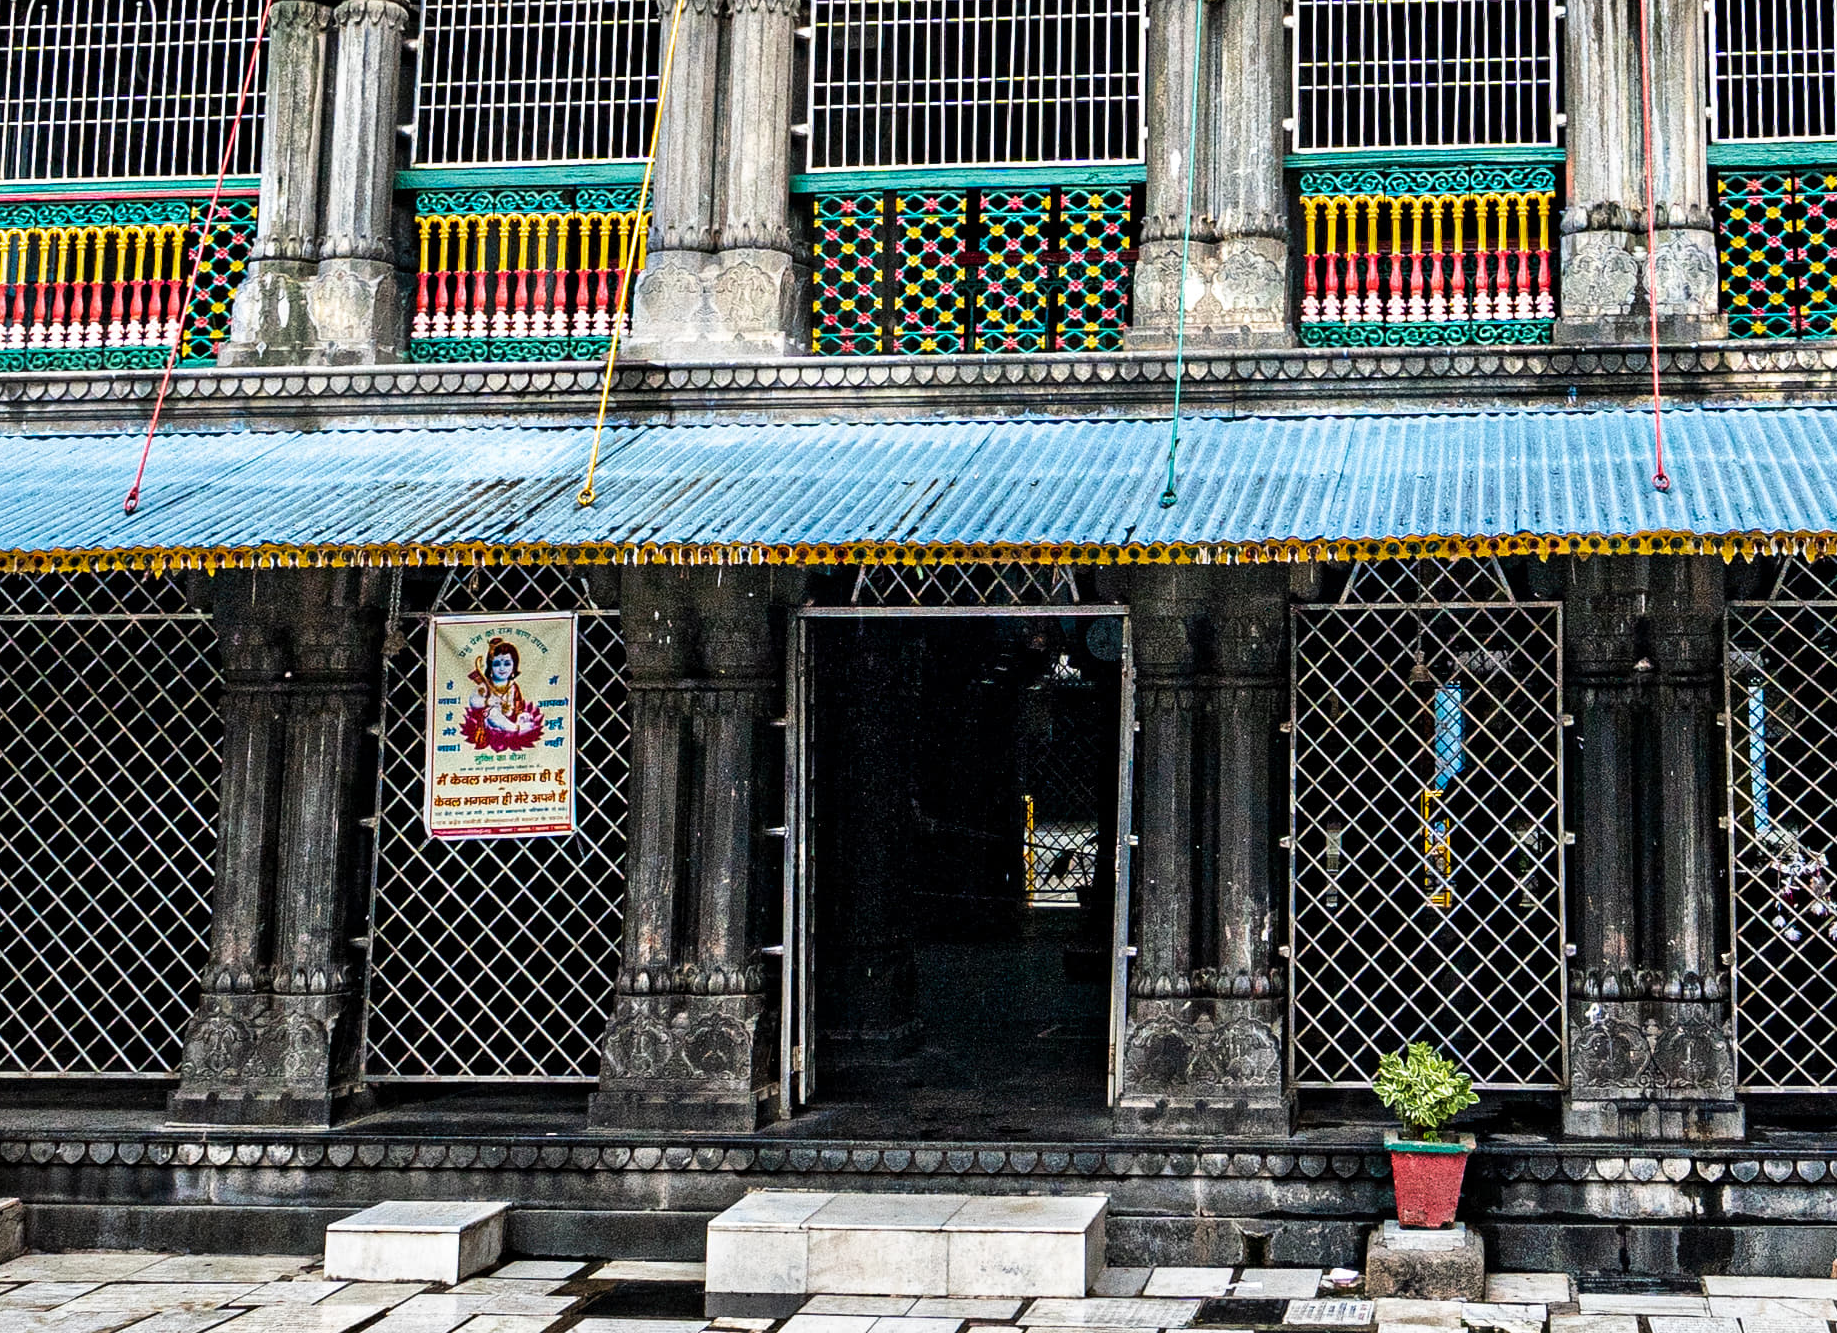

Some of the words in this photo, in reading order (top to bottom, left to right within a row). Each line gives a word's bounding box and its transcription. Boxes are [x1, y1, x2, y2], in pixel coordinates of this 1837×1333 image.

[450, 773, 480, 785] केवल
[539, 769, 551, 782] ही
[434, 794, 461, 807] केवल
[463, 796, 499, 806] भगवान
[502, 792, 512, 805] ही
[514, 791, 529, 803] मेरे
[530, 790, 556, 803] अपने
